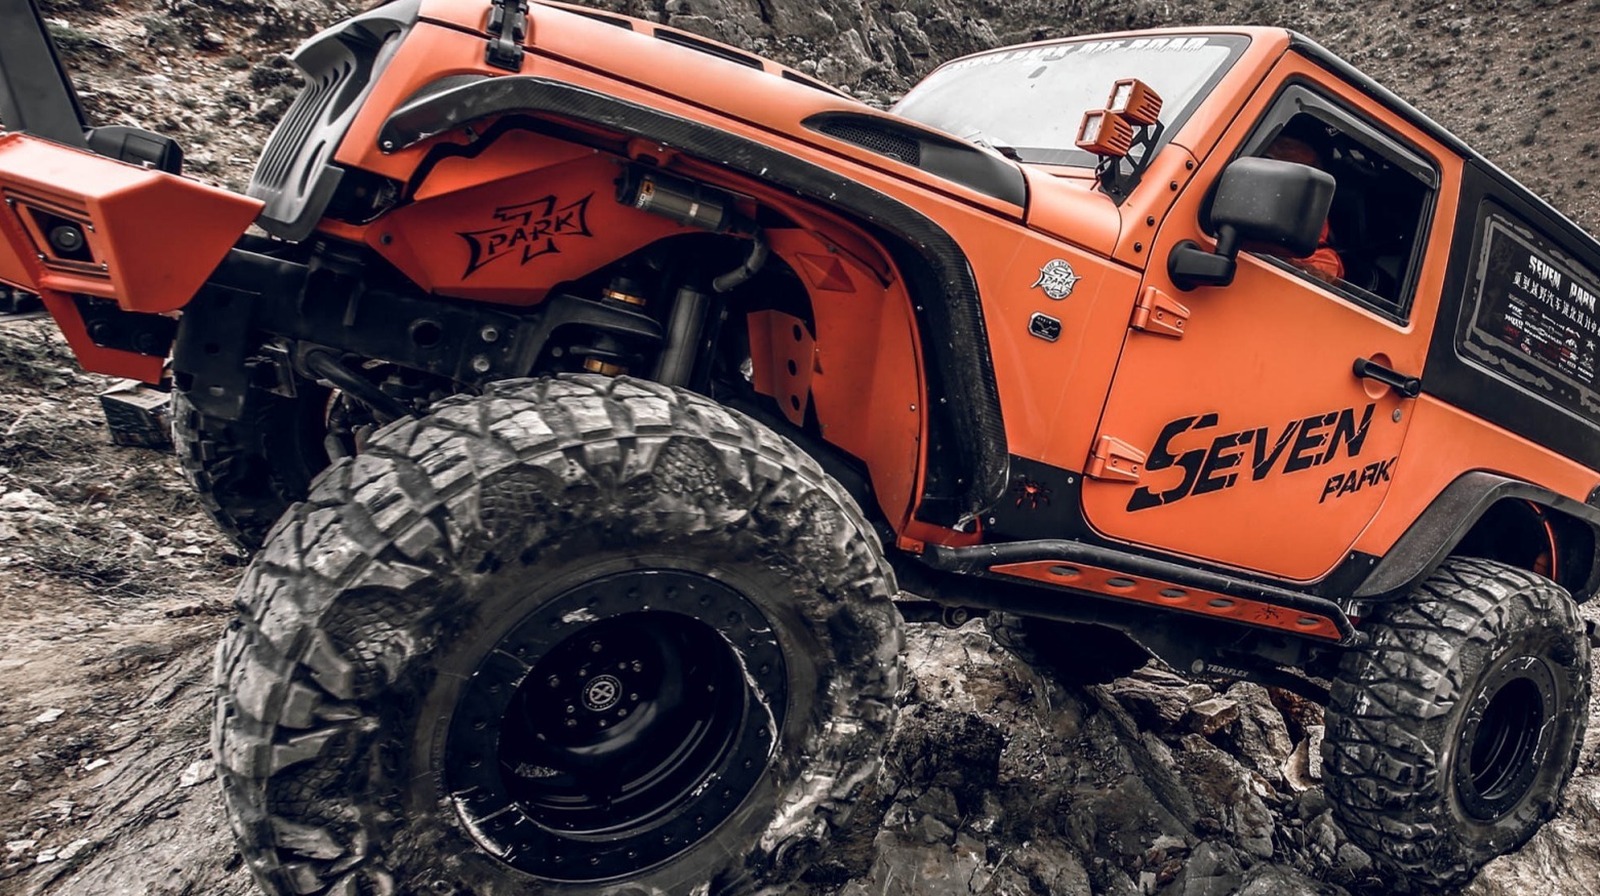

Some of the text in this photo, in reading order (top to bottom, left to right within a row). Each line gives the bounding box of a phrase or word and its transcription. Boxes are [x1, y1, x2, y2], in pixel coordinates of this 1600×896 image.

[1079, 40, 1126, 54] OFF
[1126, 37, 1210, 52] ROAD
[488, 211, 577, 256] PARK
[1044, 276, 1073, 287] PARK
[1528, 255, 1597, 315] SEVEN PARK
[1126, 403, 1377, 512] SEVEN
[1319, 456, 1397, 504] PARK
[1207, 664, 1249, 677] TERAFLEX
